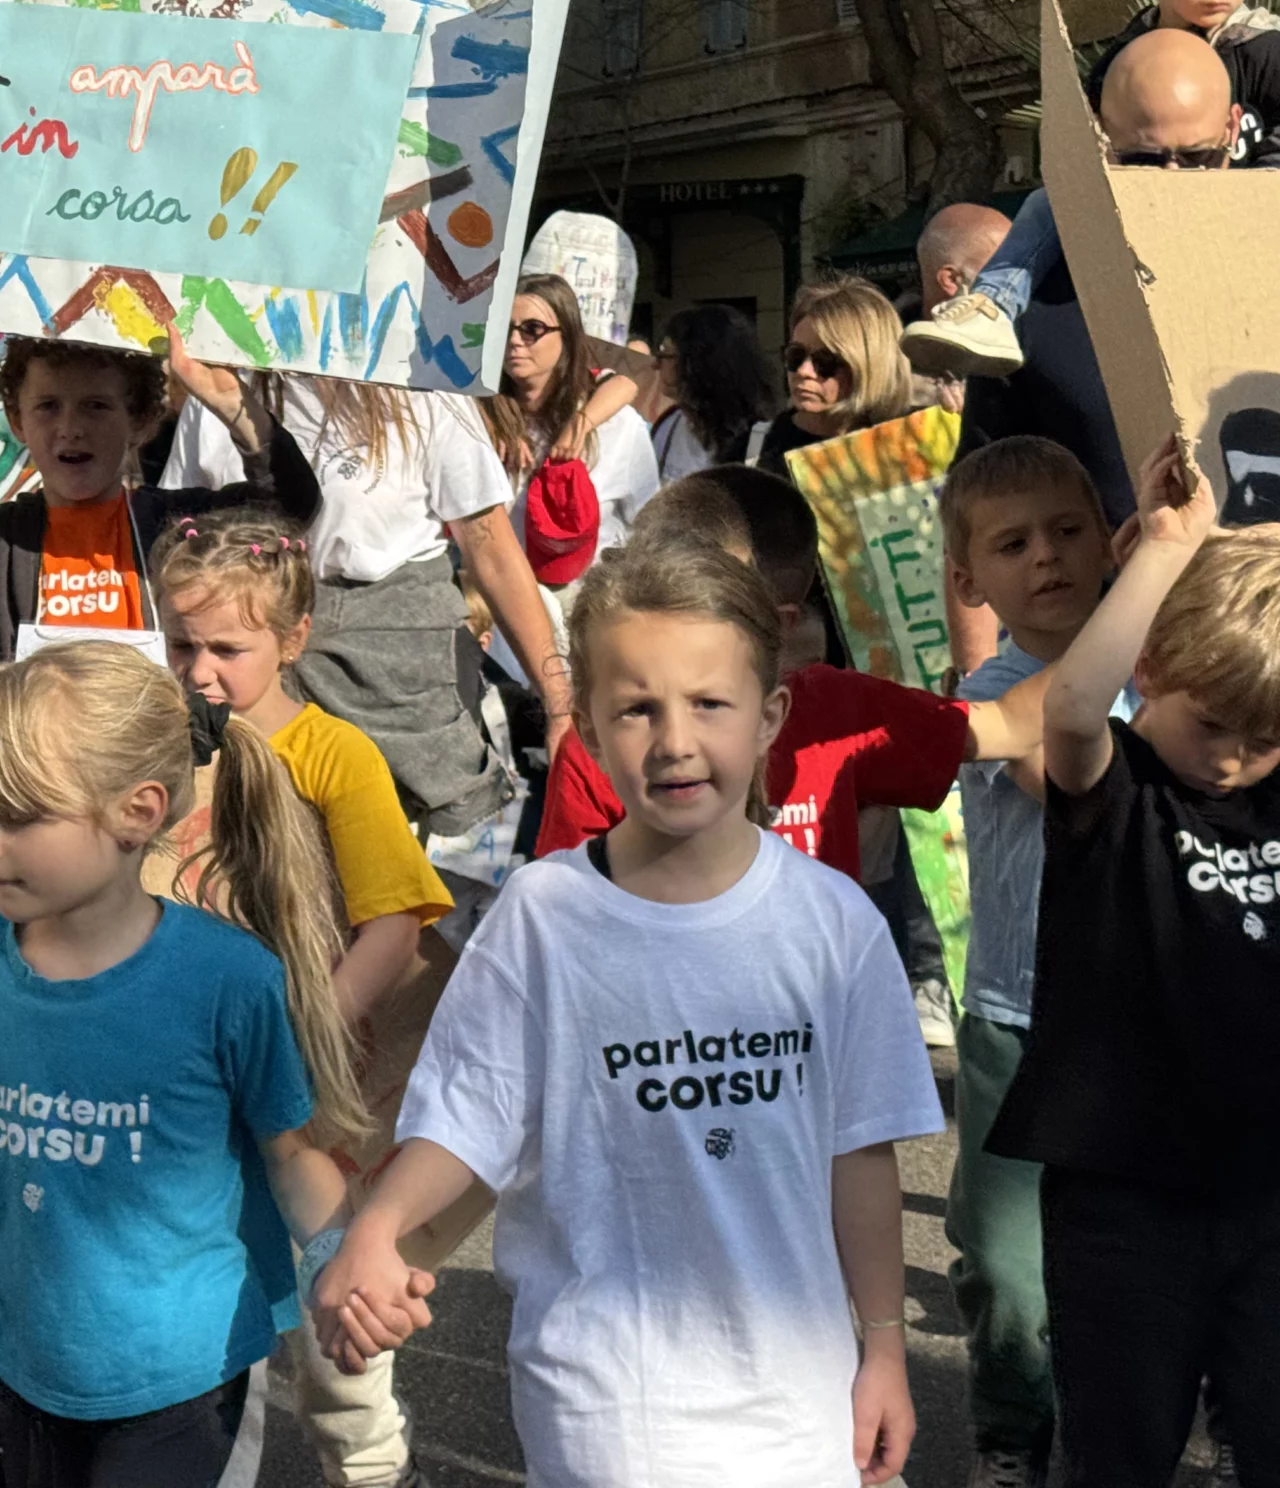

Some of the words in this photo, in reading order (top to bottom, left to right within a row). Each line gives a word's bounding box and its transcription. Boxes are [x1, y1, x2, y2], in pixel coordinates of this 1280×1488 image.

[69, 40, 261, 152] amparà
[1, 105, 79, 160] in
[46, 185, 191, 224] corsa
[659, 182, 733, 203] HOTEL
[602, 1022, 814, 1079] parlatemi
[636, 1068, 782, 1113] corsu
